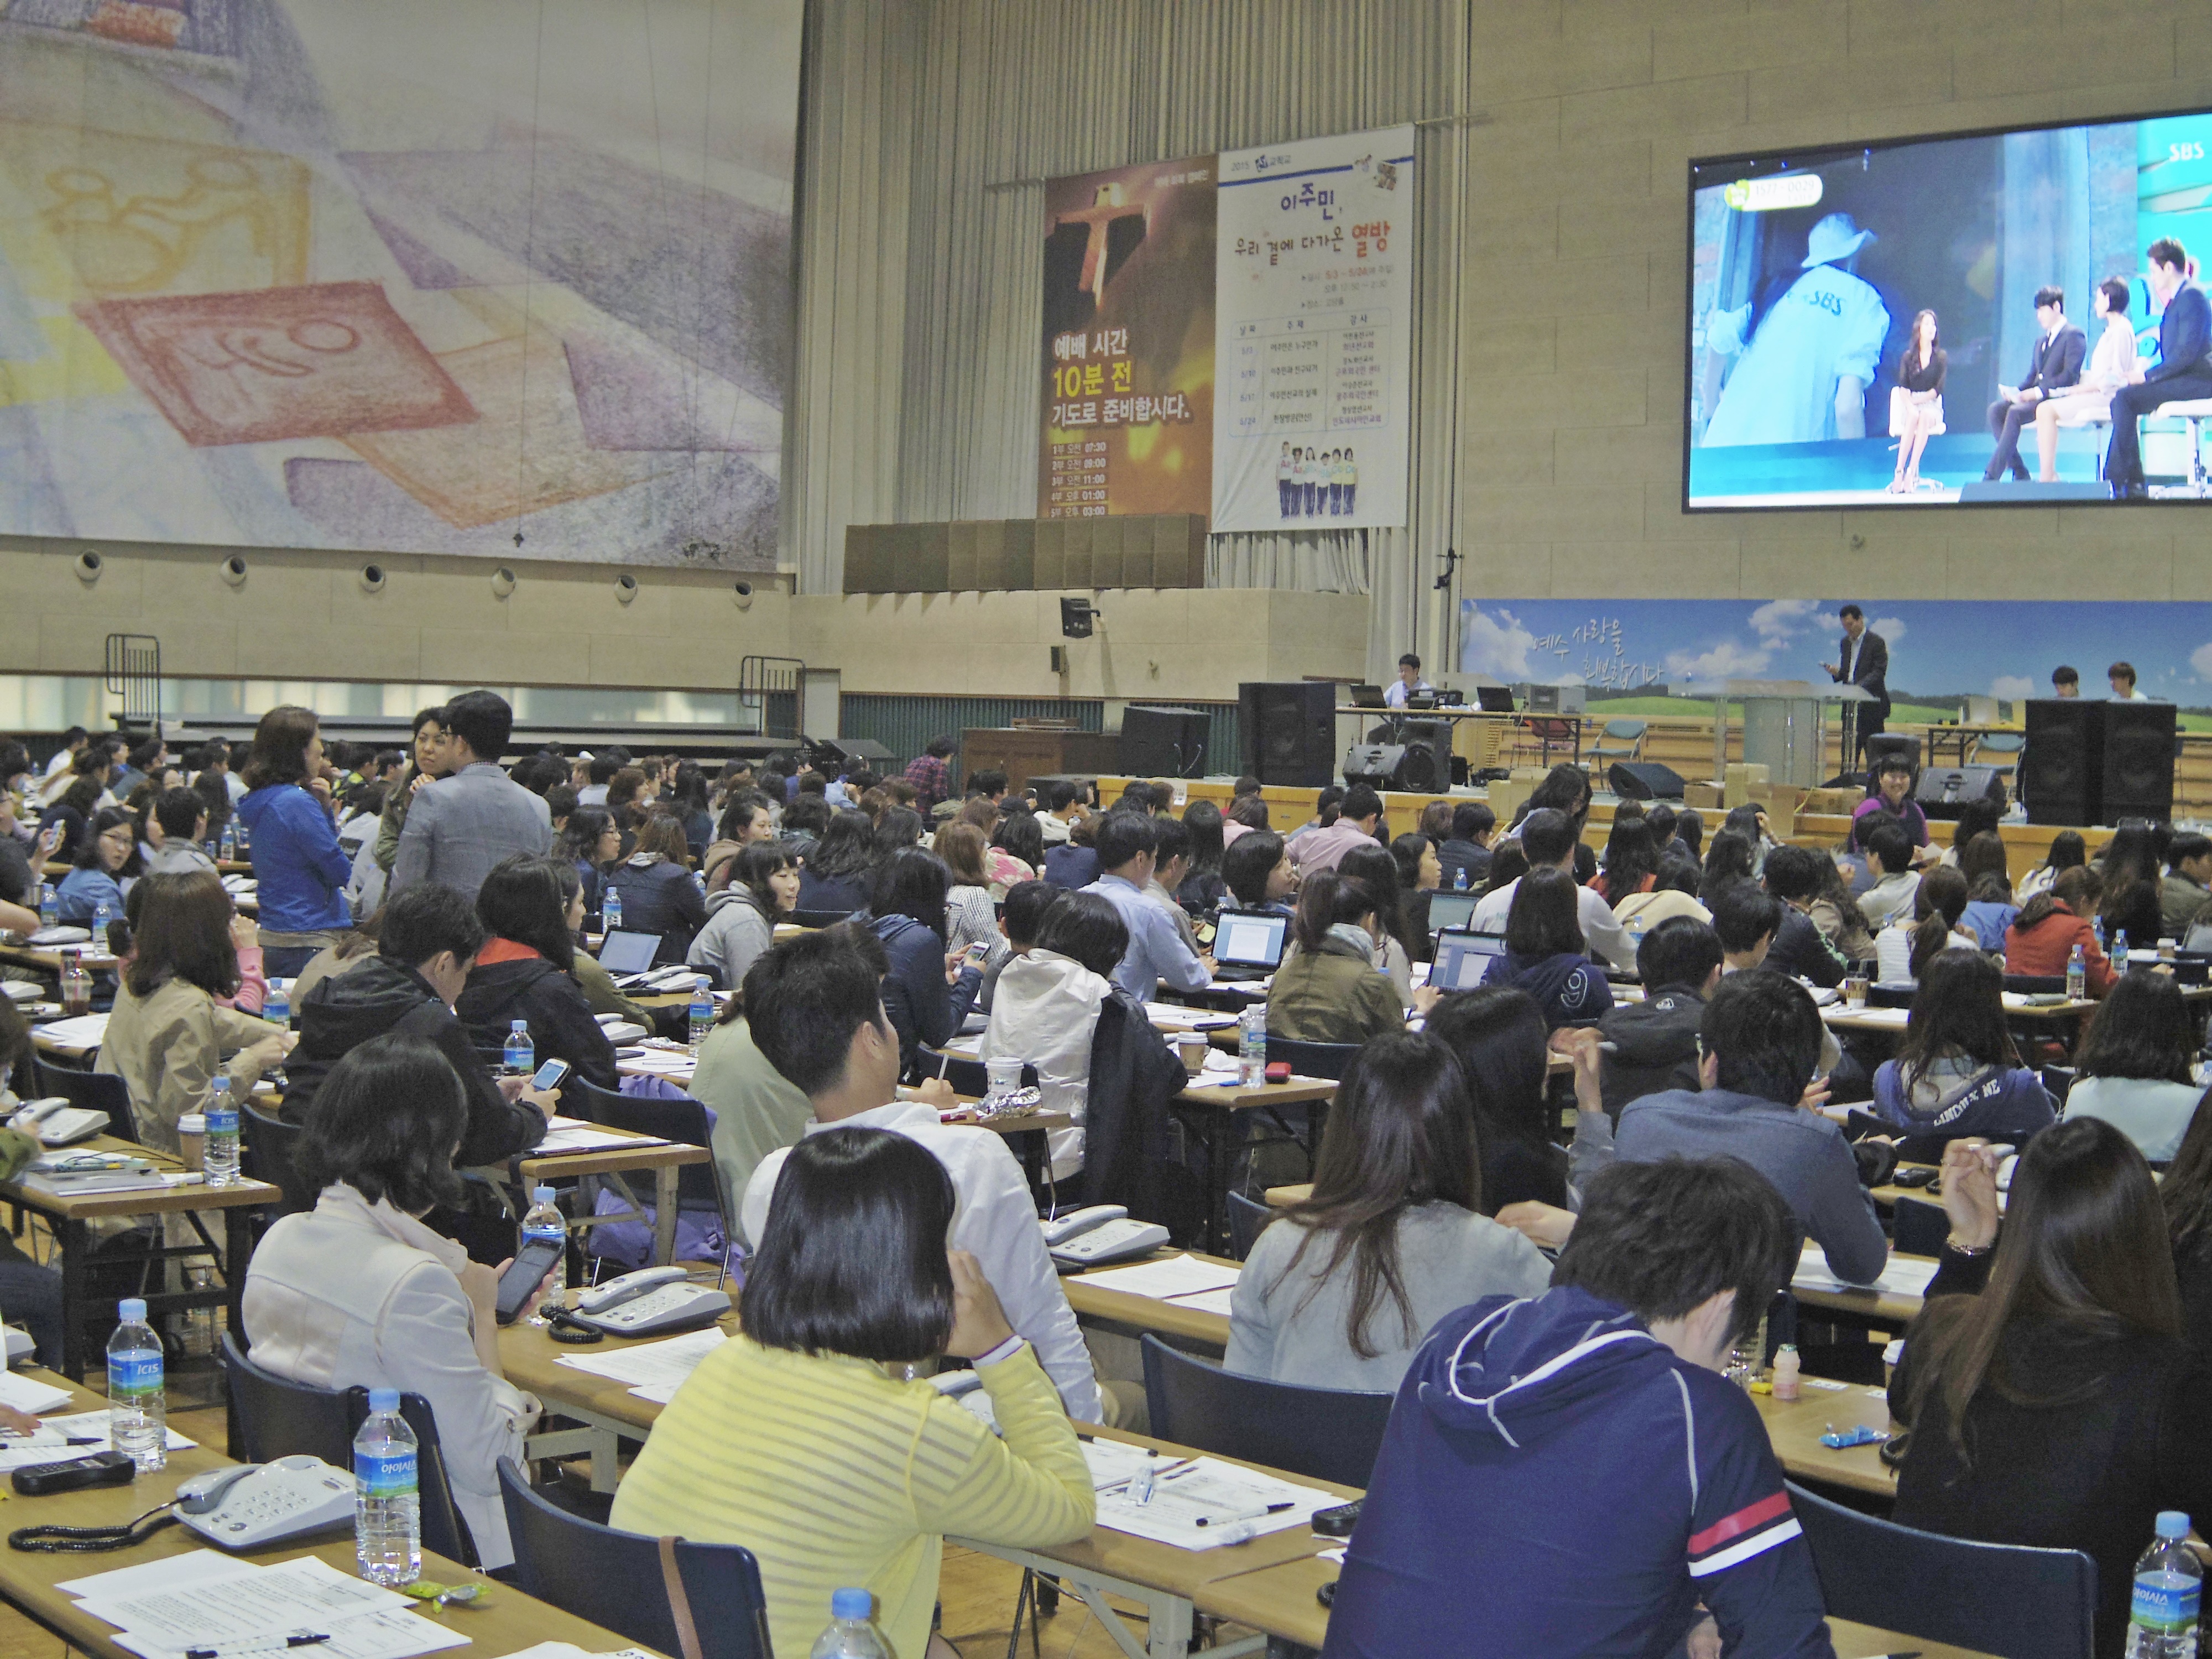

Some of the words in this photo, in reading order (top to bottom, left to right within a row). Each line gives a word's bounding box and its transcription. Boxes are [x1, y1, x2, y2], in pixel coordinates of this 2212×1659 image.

[2169, 142, 2205, 161] SBS
[1235, 238, 1260, 255] 우리
[1267, 239, 1294, 266] 곁에
[1301, 226, 1344, 252] 다가온
[1352, 221, 1391, 258] 열방
[1809, 290, 1845, 316] SBS
[1055, 333, 1087, 360] 예배
[1093, 328, 1128, 357] 시간
[1054, 363, 1104, 398] 10분
[1112, 360, 1131, 392] 전
[1052, 402, 1098, 427] 기도로
[1102, 394, 1190, 423] 준비합시다.
[1532, 634, 1569, 662] 예수
[1573, 617, 1625, 657] 사랑을
[1583, 654, 1665, 692] 회복합시다
[1561, 968, 1588, 1008] 9
[1982, 1078, 2001, 1098] NE
[138, 1363, 159, 1375] ICIS
